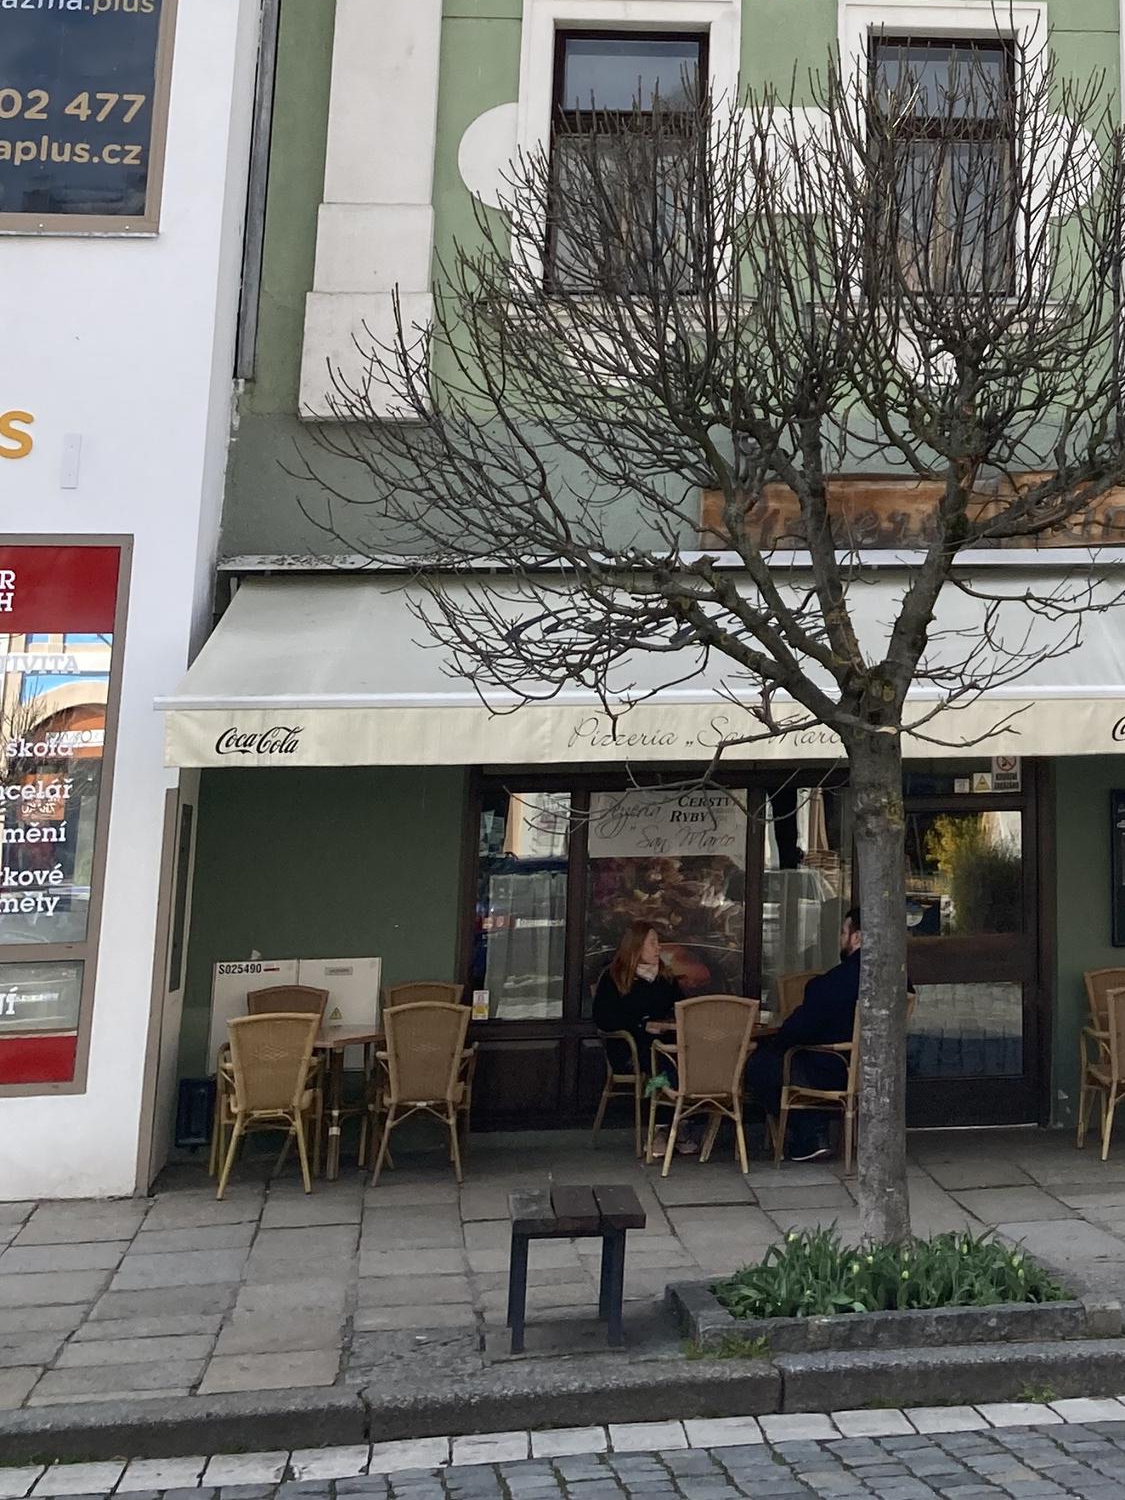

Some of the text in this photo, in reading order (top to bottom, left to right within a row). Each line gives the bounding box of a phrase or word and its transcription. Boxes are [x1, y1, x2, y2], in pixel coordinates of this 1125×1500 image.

[0, 88, 146, 123] 02 477
[0, 135, 142, 166] aplus.cz
[215, 726, 305, 755] Coca-Cola
[0, 863, 64, 886] kové
